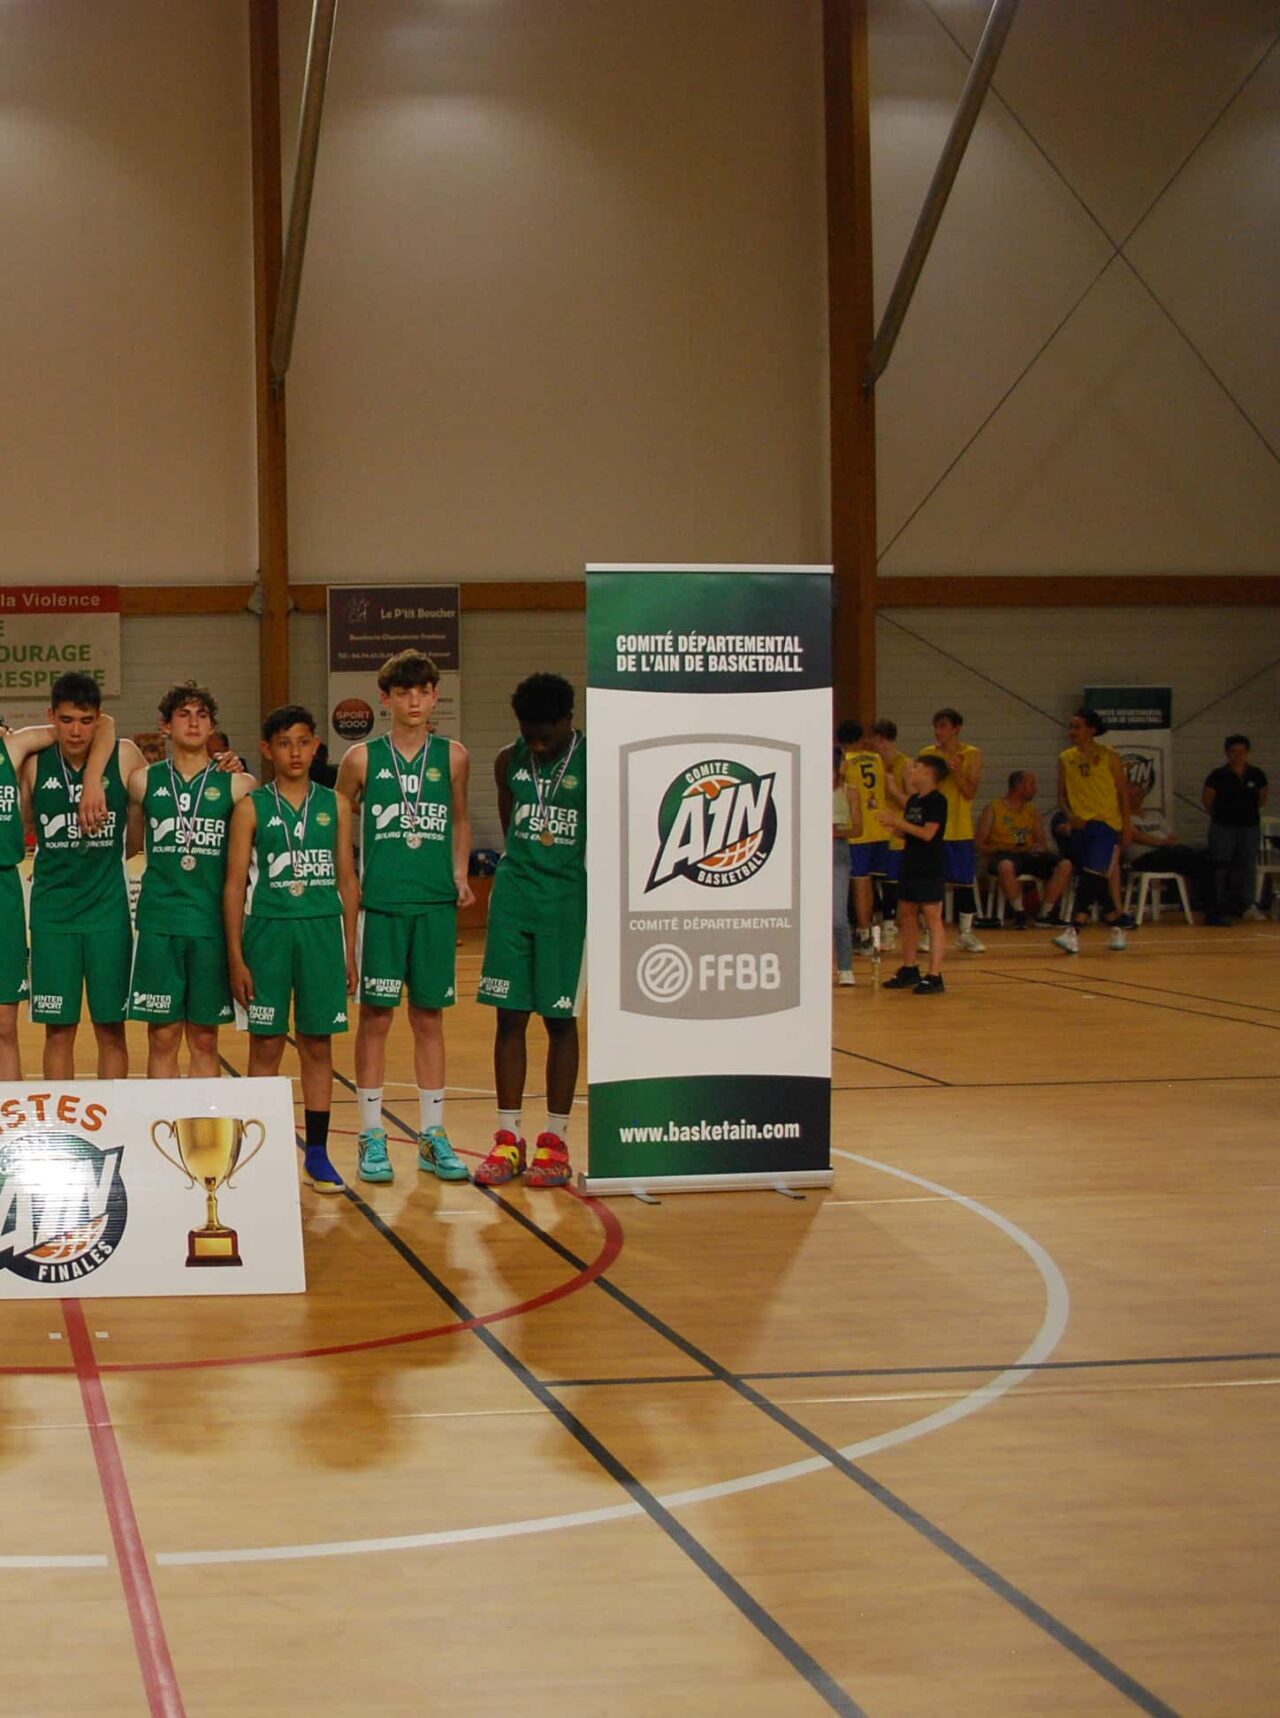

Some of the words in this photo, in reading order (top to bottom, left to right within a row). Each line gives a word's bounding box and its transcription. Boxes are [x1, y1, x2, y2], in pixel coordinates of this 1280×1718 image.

[1, 594, 16, 607] la
[22, 593, 100, 608] Violence
[616, 630, 674, 653] COMITÉ
[678, 630, 804, 654] DÉPARTEMENTAL
[616, 655, 637, 673] DE
[641, 655, 680, 672] L'AIN
[685, 655, 704, 672] DE
[708, 655, 804, 672] BASKETBALL
[685, 762, 729, 784] COMITE
[859, 763, 877, 789] 5
[399, 774, 419, 793] 10
[179, 793, 191, 812] 9
[401, 801, 448, 819] INTER
[531, 803, 578, 823] INTER
[176, 816, 225, 834] INTER
[293, 821, 304, 841] 4
[175, 830, 224, 846] SPORT
[697, 851, 768, 885] BASKETBALL
[629, 916, 679, 931] COMITÉ
[683, 916, 792, 931] DÉPARTEMENTAL
[699, 953, 781, 991] FFBB
[376, 978, 401, 988] INTER
[146, 994, 171, 1003] INTER
[619, 1119, 800, 1143] www.basketain.com
[38, 1241, 113, 1282] FINALES
